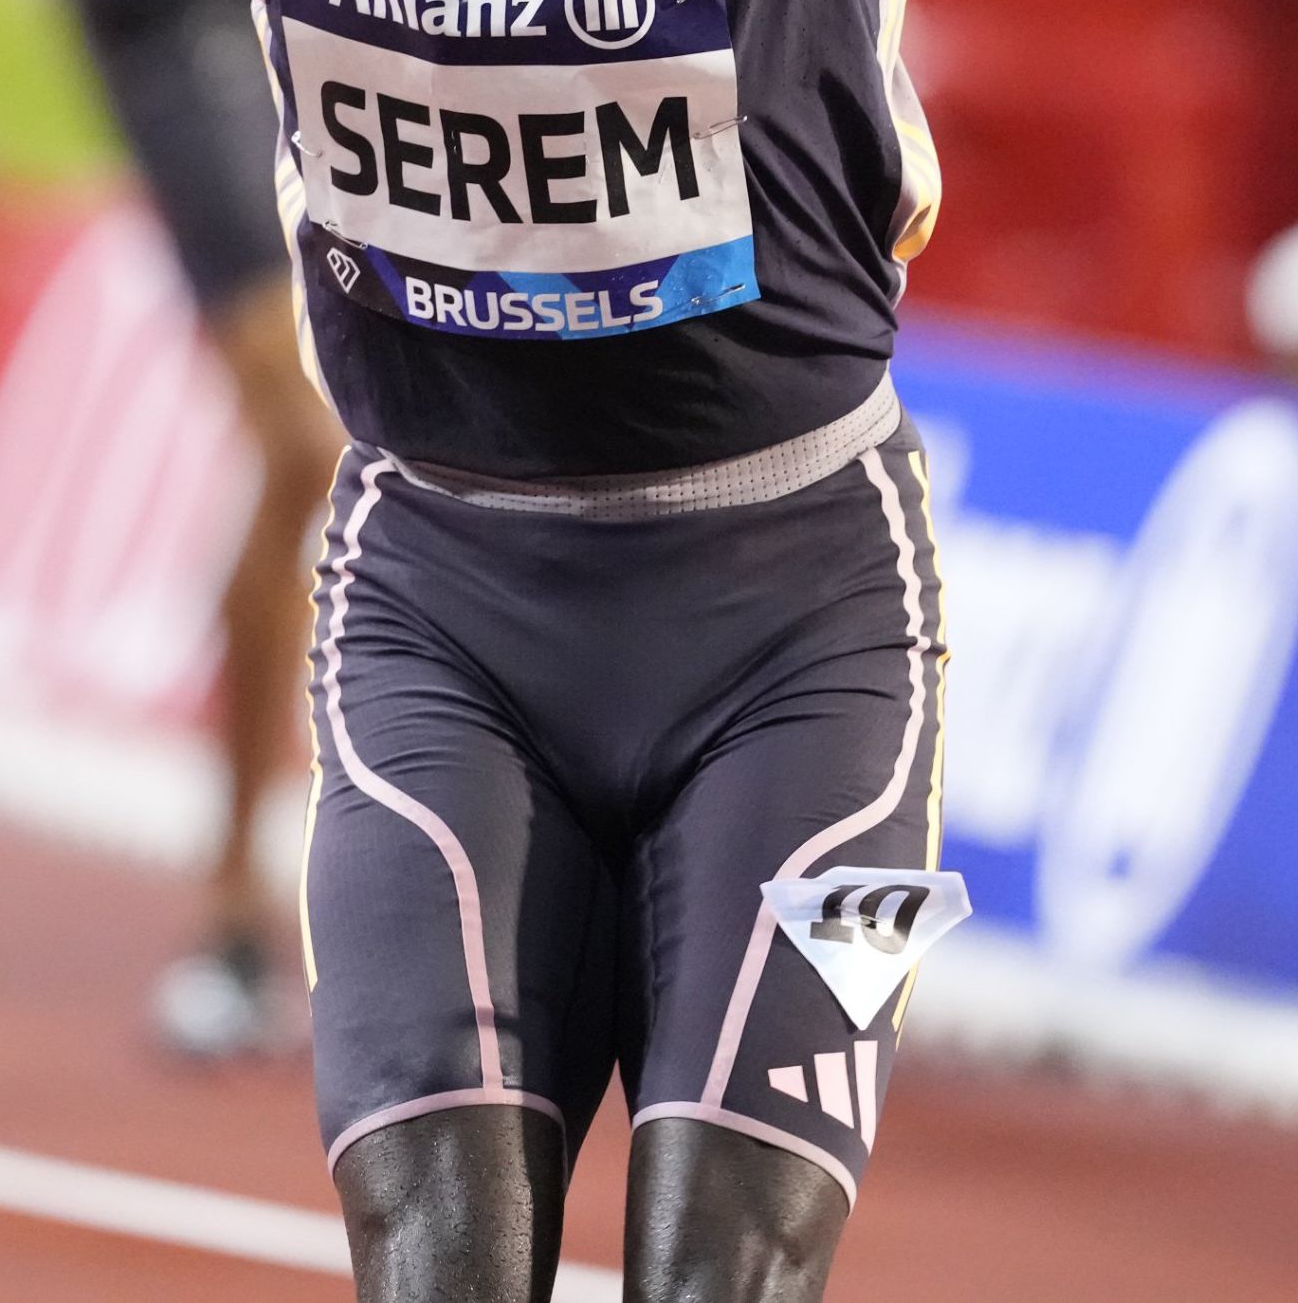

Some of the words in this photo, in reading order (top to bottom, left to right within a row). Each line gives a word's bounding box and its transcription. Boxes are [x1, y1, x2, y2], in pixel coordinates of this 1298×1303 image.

[320, 80, 700, 225] SEREM
[404, 275, 664, 332] BRUSSELS
[809, 883, 931, 955] 10
